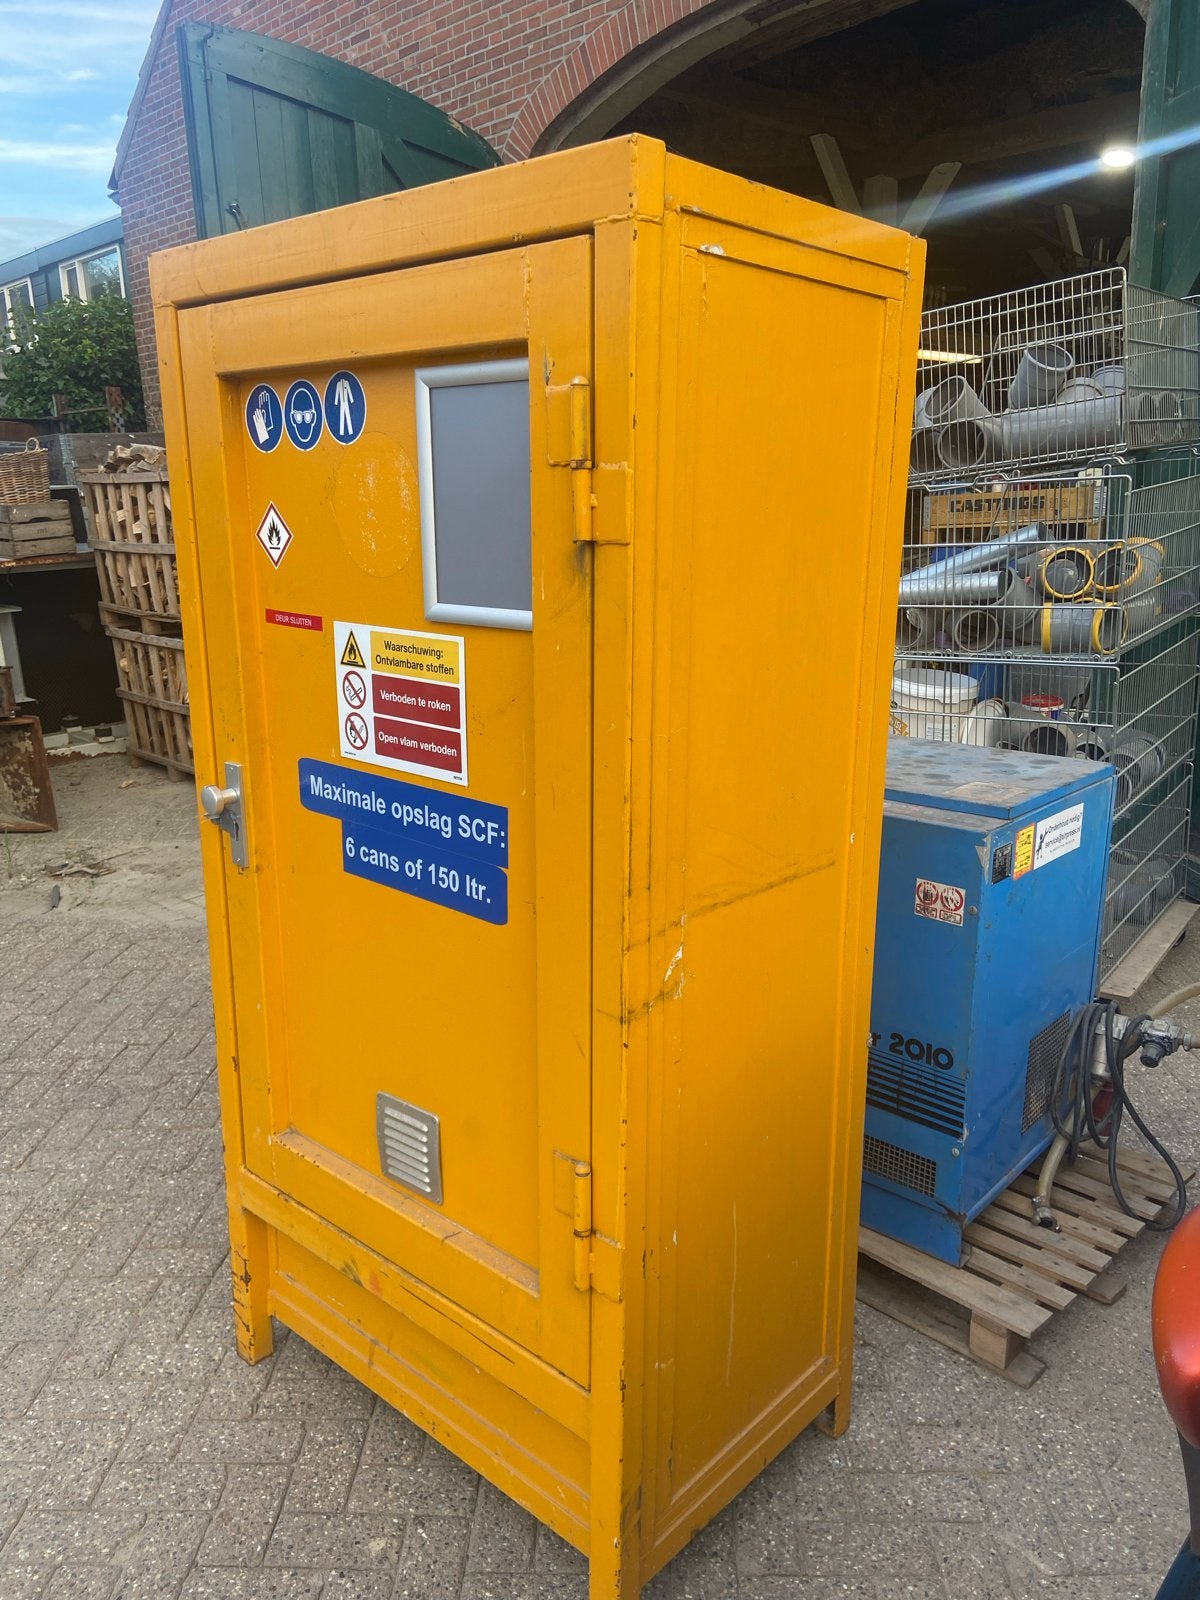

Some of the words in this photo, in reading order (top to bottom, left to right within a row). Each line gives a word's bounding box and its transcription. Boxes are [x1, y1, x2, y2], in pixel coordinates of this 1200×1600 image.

[275, 613, 290, 623] DEUR
[290, 616, 313, 626] SLUITEN
[384, 640, 444, 660] Waarschuwing:
[375, 654, 424, 671] Ontvlambare
[425, 663, 455, 676] stoffen
[380, 689, 417, 706] Verboden
[417, 697, 427, 708] te
[427, 699, 452, 712] roken
[378, 731, 399, 746] Open
[399, 736, 419, 749] vlam
[419, 742, 458, 757] verboden
[309, 774, 387, 816] Maximale
[391, 801, 453, 839] opslag
[457, 813, 506, 849] SCF:
[345, 836, 356, 858] 6
[359, 845, 401, 873] cans
[404, 858, 424, 881] of
[428, 863, 460, 893] 150
[465, 874, 492, 904] ltr.
[889, 1031, 954, 1071] 2010
